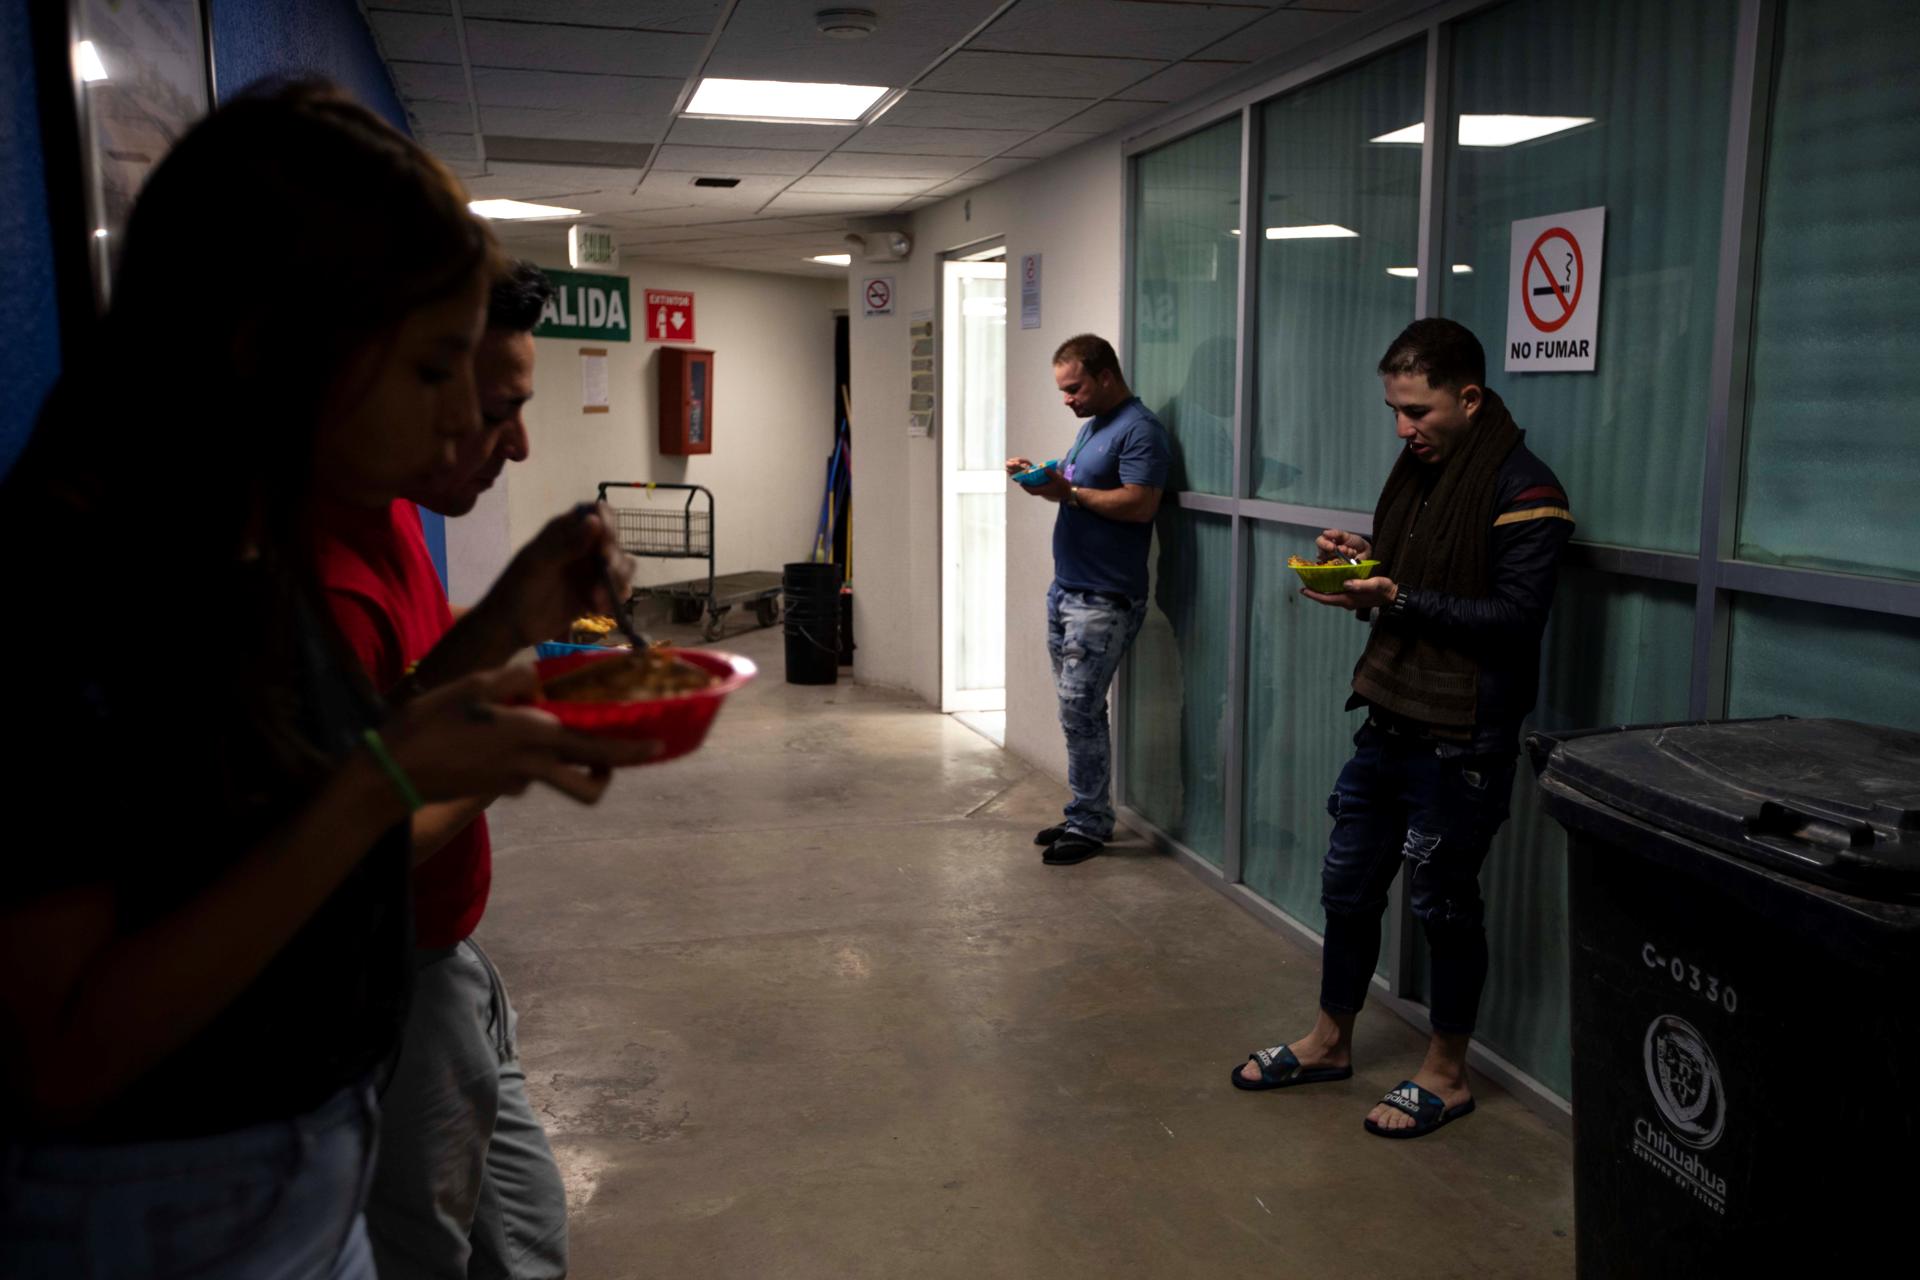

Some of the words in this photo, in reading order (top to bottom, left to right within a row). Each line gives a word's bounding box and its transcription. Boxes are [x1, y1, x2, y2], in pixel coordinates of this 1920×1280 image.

[536, 286, 627, 331] ALIDA
[1510, 341, 1531, 359] NO
[1535, 339, 1590, 359] FUMAR
[1641, 941, 1738, 1013] C-0330
[1384, 1093, 1420, 1112] adidas
[1634, 1117, 1727, 1197] Chihuahua
